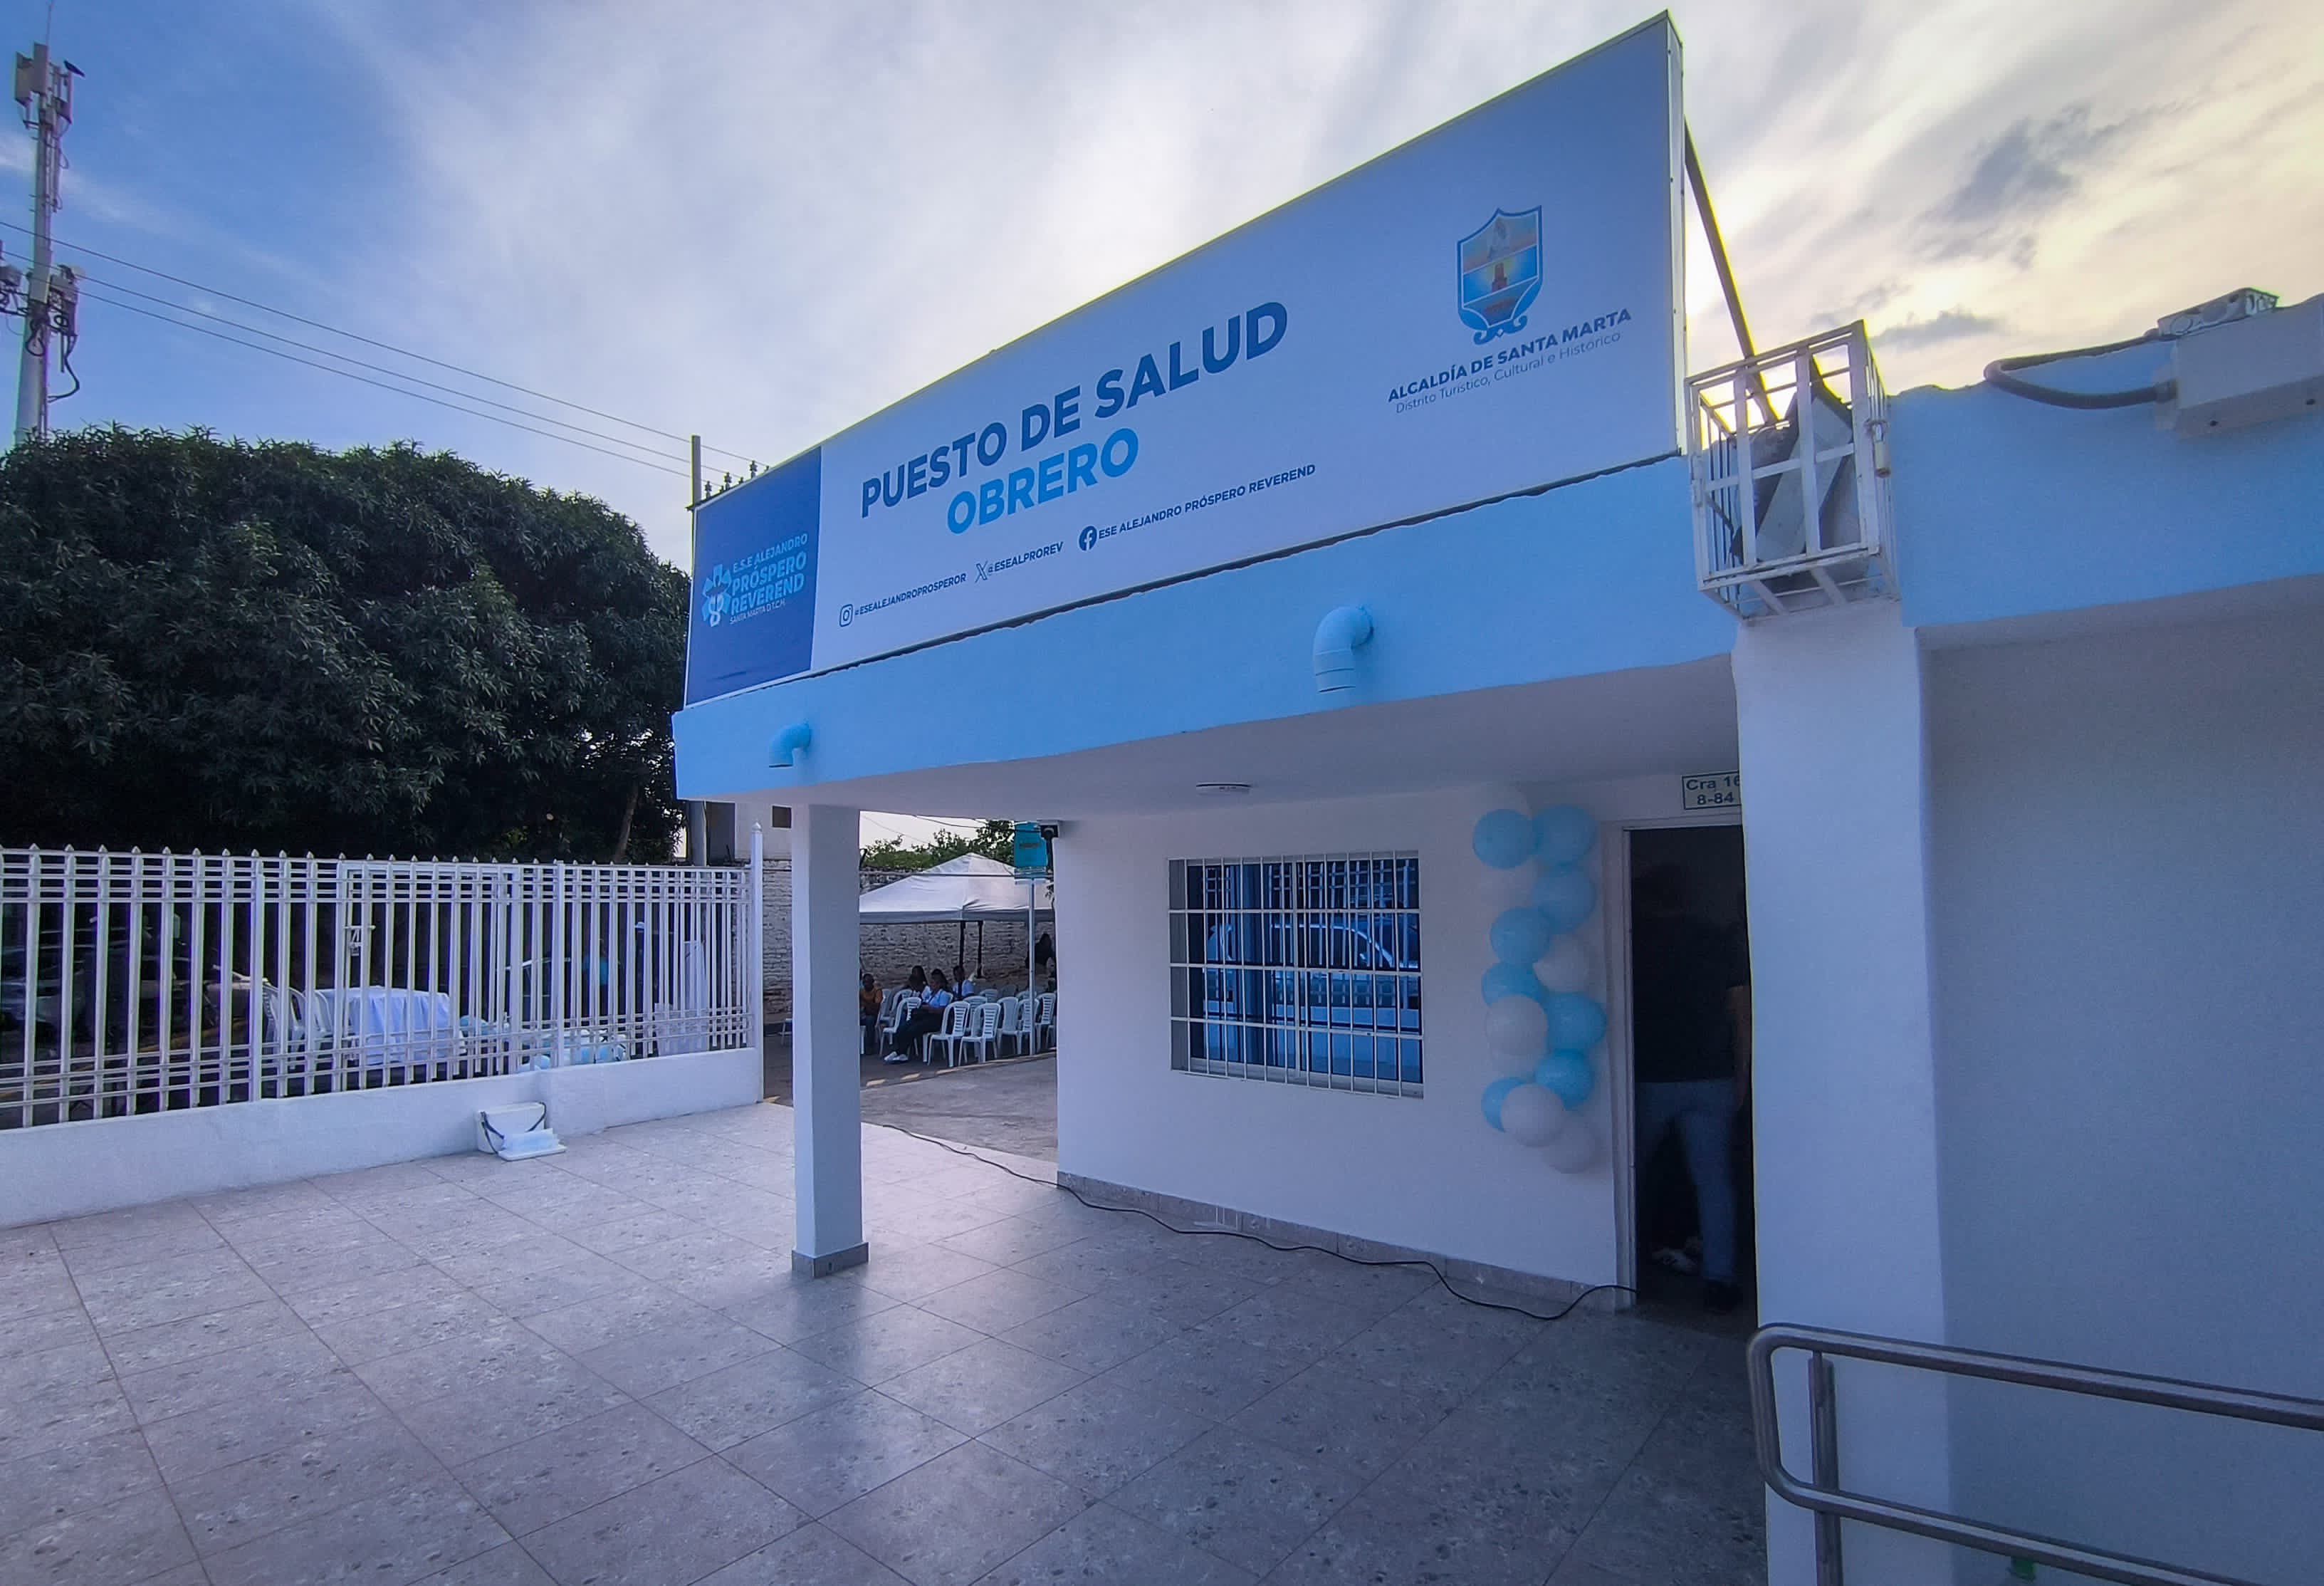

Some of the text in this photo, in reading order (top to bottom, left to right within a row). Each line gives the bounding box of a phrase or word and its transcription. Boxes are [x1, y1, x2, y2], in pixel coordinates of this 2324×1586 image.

[1388, 308, 1632, 402] ALCALDÍA DE SANTA MARTA
[1396, 394, 1436, 413] Distrito
[1494, 357, 1544, 380] Cultural
[1547, 353, 1556, 365] e
[862, 301, 1288, 518] PUESTO DE SALUD
[947, 428, 1139, 534] OBRERO
[1099, 464, 1316, 539] ESE ALEJANDRO PRÓSPERO REVEREND
[732, 551, 807, 596] PRÓSPERO
[754, 533, 808, 565] ALEJANDRO
[731, 573, 805, 615] REVEREND
[1686, 779, 1716, 790] Cra
[1697, 792, 1734, 805] 8-84
